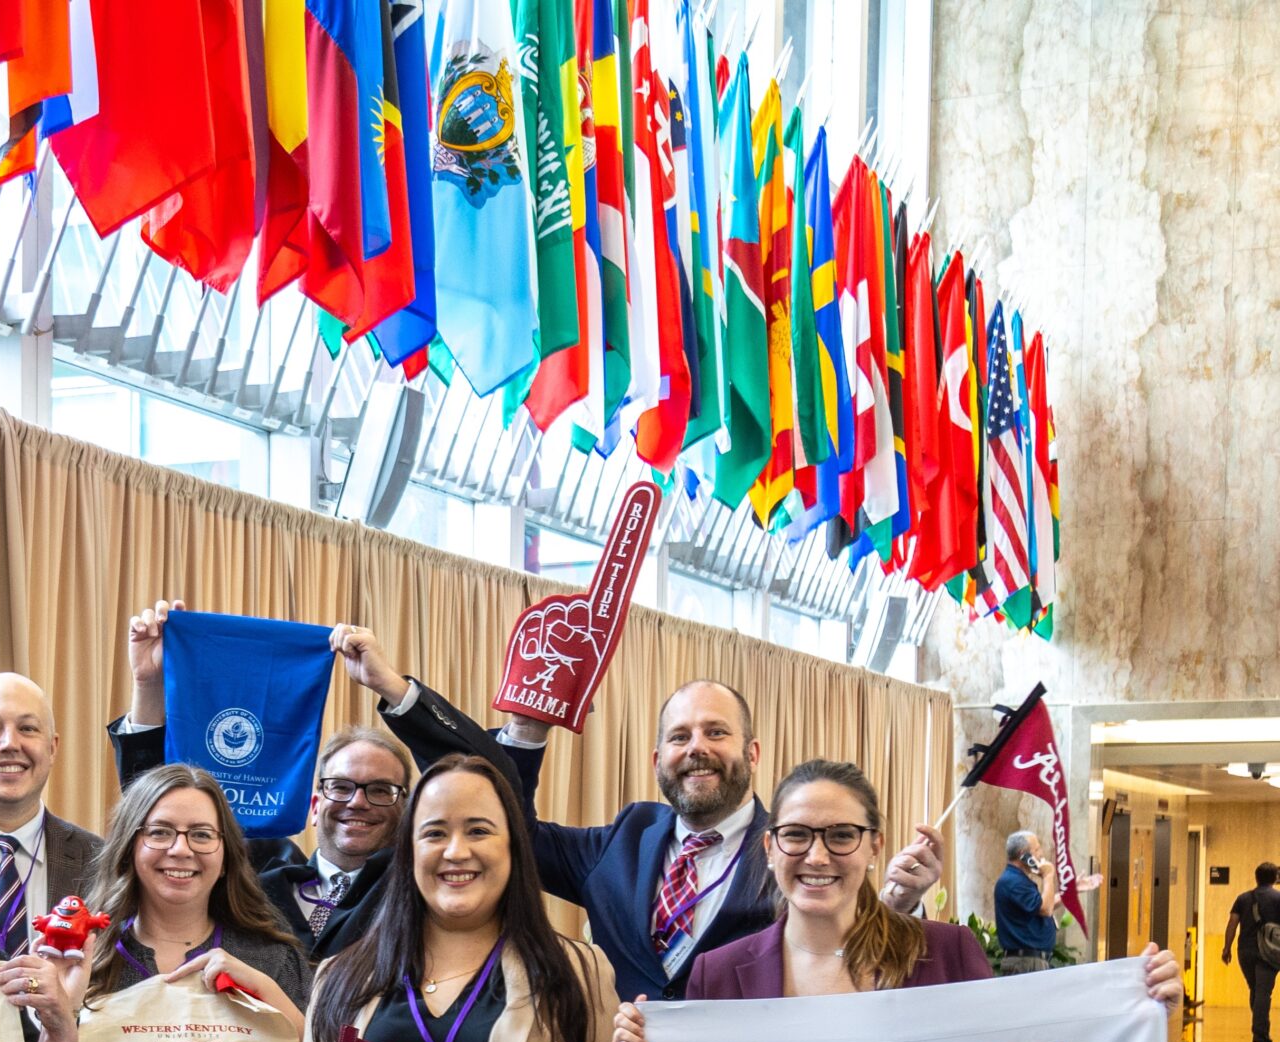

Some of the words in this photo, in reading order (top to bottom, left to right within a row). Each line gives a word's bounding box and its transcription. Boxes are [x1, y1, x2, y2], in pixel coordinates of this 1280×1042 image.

[616, 502, 643, 558] ROLL
[597, 562, 624, 619] TIDE
[504, 684, 571, 719] ALABAMA
[207, 770, 232, 781] ERSITY
[237, 807, 279, 816] COLLEGE
[121, 1025, 180, 1034] WESTERN
[185, 1024, 253, 1035] KENTUCKY
